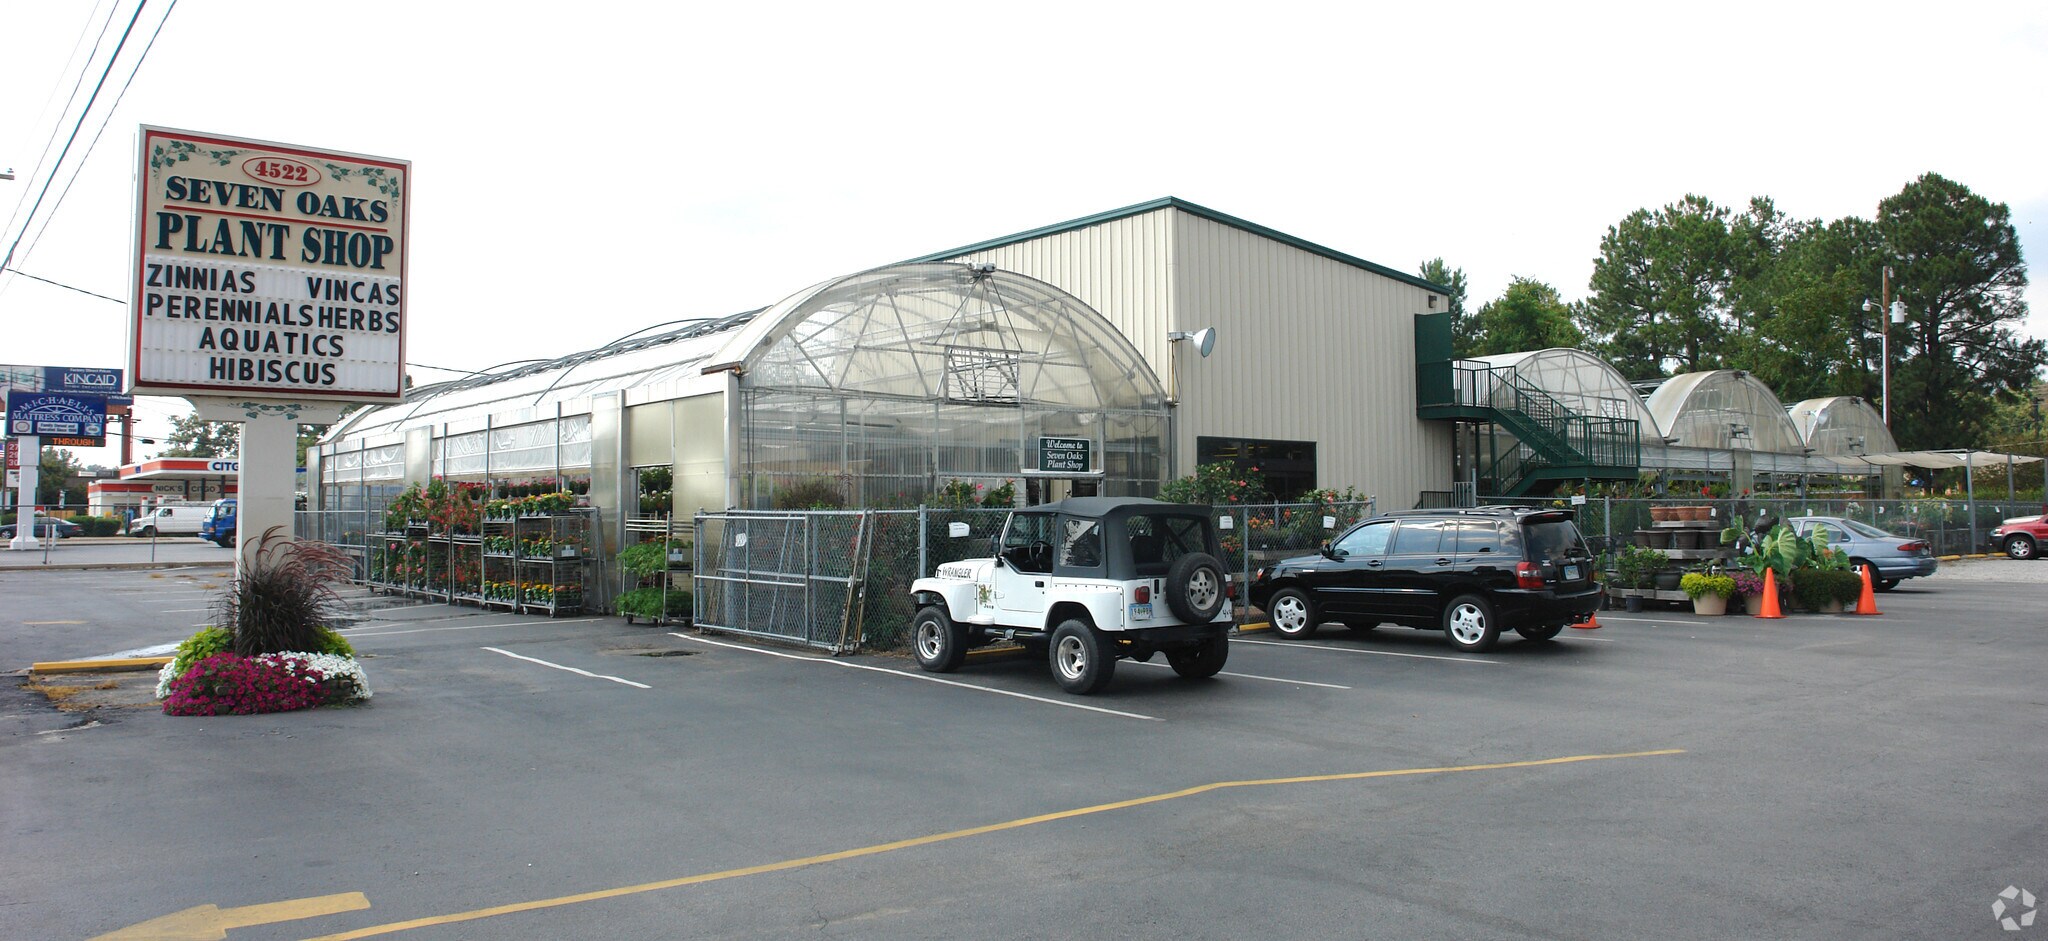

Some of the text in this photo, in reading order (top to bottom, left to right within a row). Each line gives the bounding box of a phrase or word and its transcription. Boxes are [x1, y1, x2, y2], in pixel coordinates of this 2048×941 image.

[254, 160, 308, 182] 4522
[165, 175, 389, 223] SEVEN OAKS
[155, 211, 394, 270] PLANT SHOP
[146, 264, 400, 306] ZINNIAS VINCAS
[146, 293, 400, 334] PERENNIALS HERBS
[199, 326, 344, 358] AQUATICS
[209, 356, 336, 386] HIBISCUS
[64, 373, 117, 386] KINCAID
[12, 410, 104, 423] MATTRESS COMPANY
[52, 437, 95, 446] THROUGH
[1046, 439, 1084, 450] Welcome to
[1046, 451, 1084, 460] Seven Oaks
[212, 461, 239, 471] CITG
[1046, 459, 1084, 471] Plant Shop
[942, 566, 972, 579] WRANGLER
